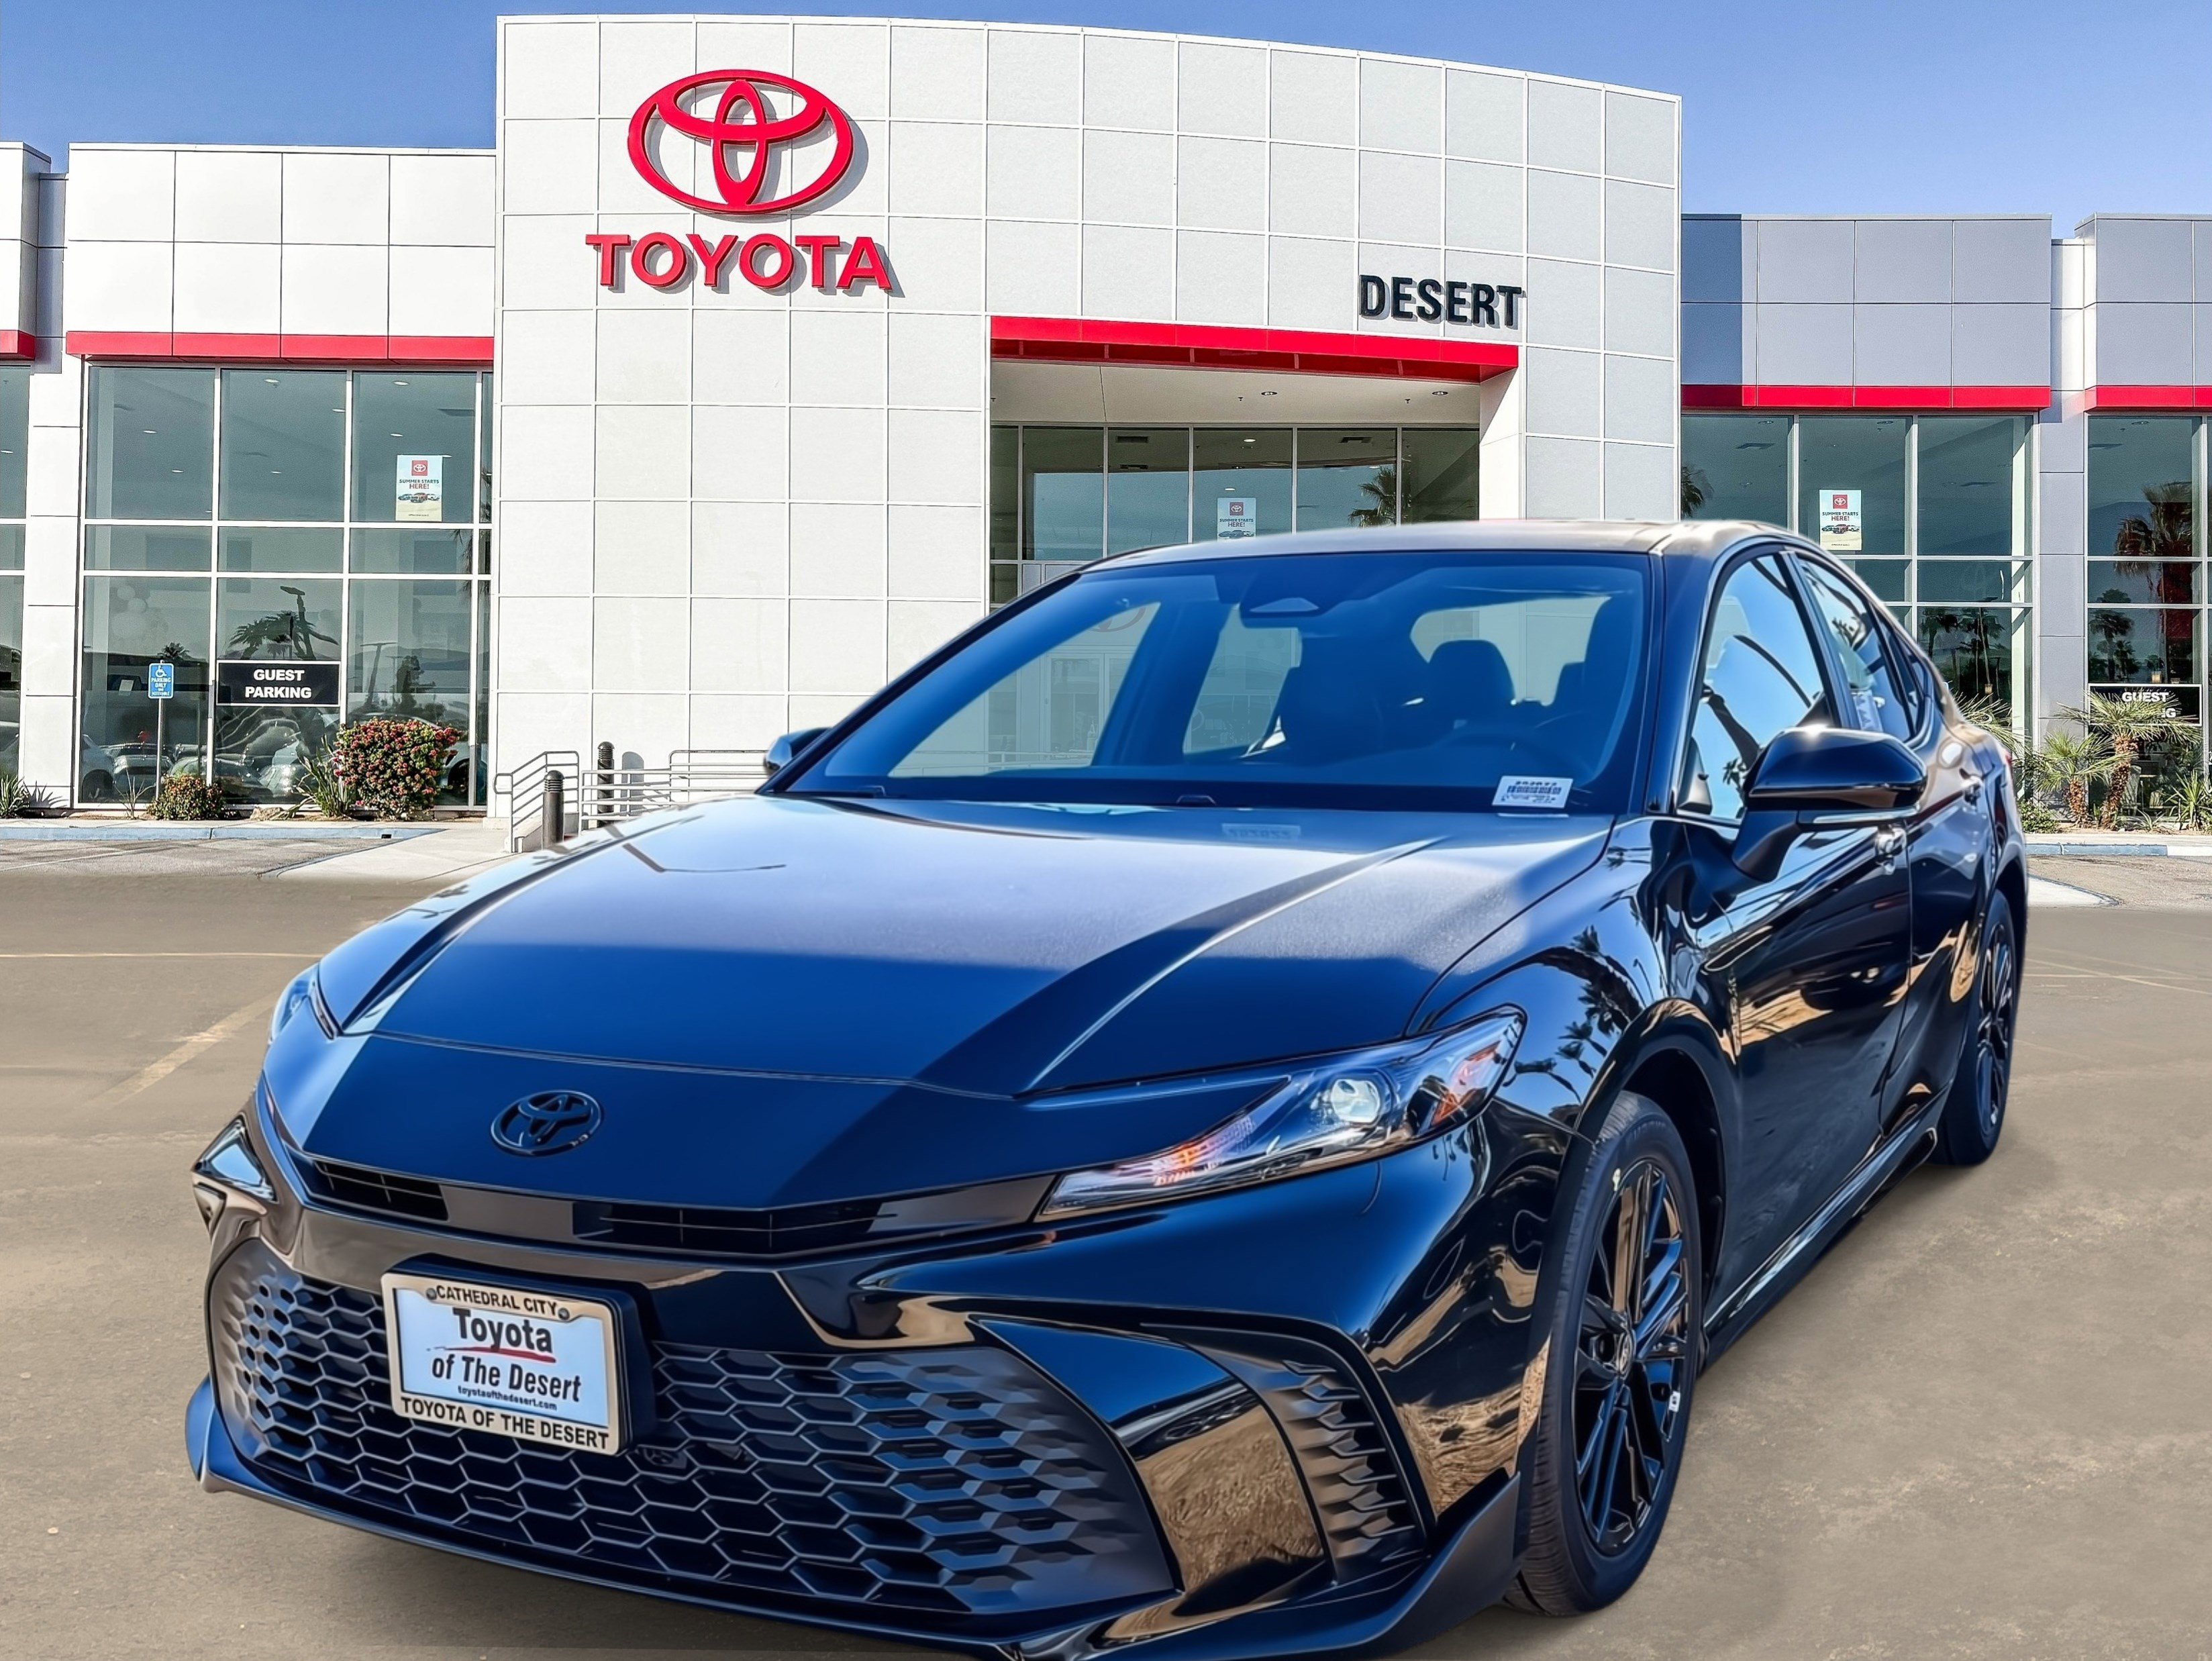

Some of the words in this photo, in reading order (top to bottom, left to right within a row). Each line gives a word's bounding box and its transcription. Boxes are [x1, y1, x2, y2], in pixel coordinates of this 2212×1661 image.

[585, 232, 893, 290] TOYOTA
[1359, 274, 1522, 326] DESERT
[245, 686, 312, 699] PARKING
[253, 669, 305, 681] GUEST
[2121, 691, 2170, 702] GUEST
[436, 1285, 519, 1310] CATHEDRAL
[523, 1298, 558, 1316] CITY
[452, 1307, 553, 1353] Toyota
[432, 1354, 455, 1380] of
[462, 1356, 501, 1387] The
[508, 1363, 581, 1403] Desert
[458, 1385, 558, 1411] toyotaofthedesert.com
[401, 1396, 467, 1423] TOYOTA
[472, 1409, 496, 1428] OF
[501, 1414, 536, 1435] THE
[540, 1421, 609, 1450] DESERT
